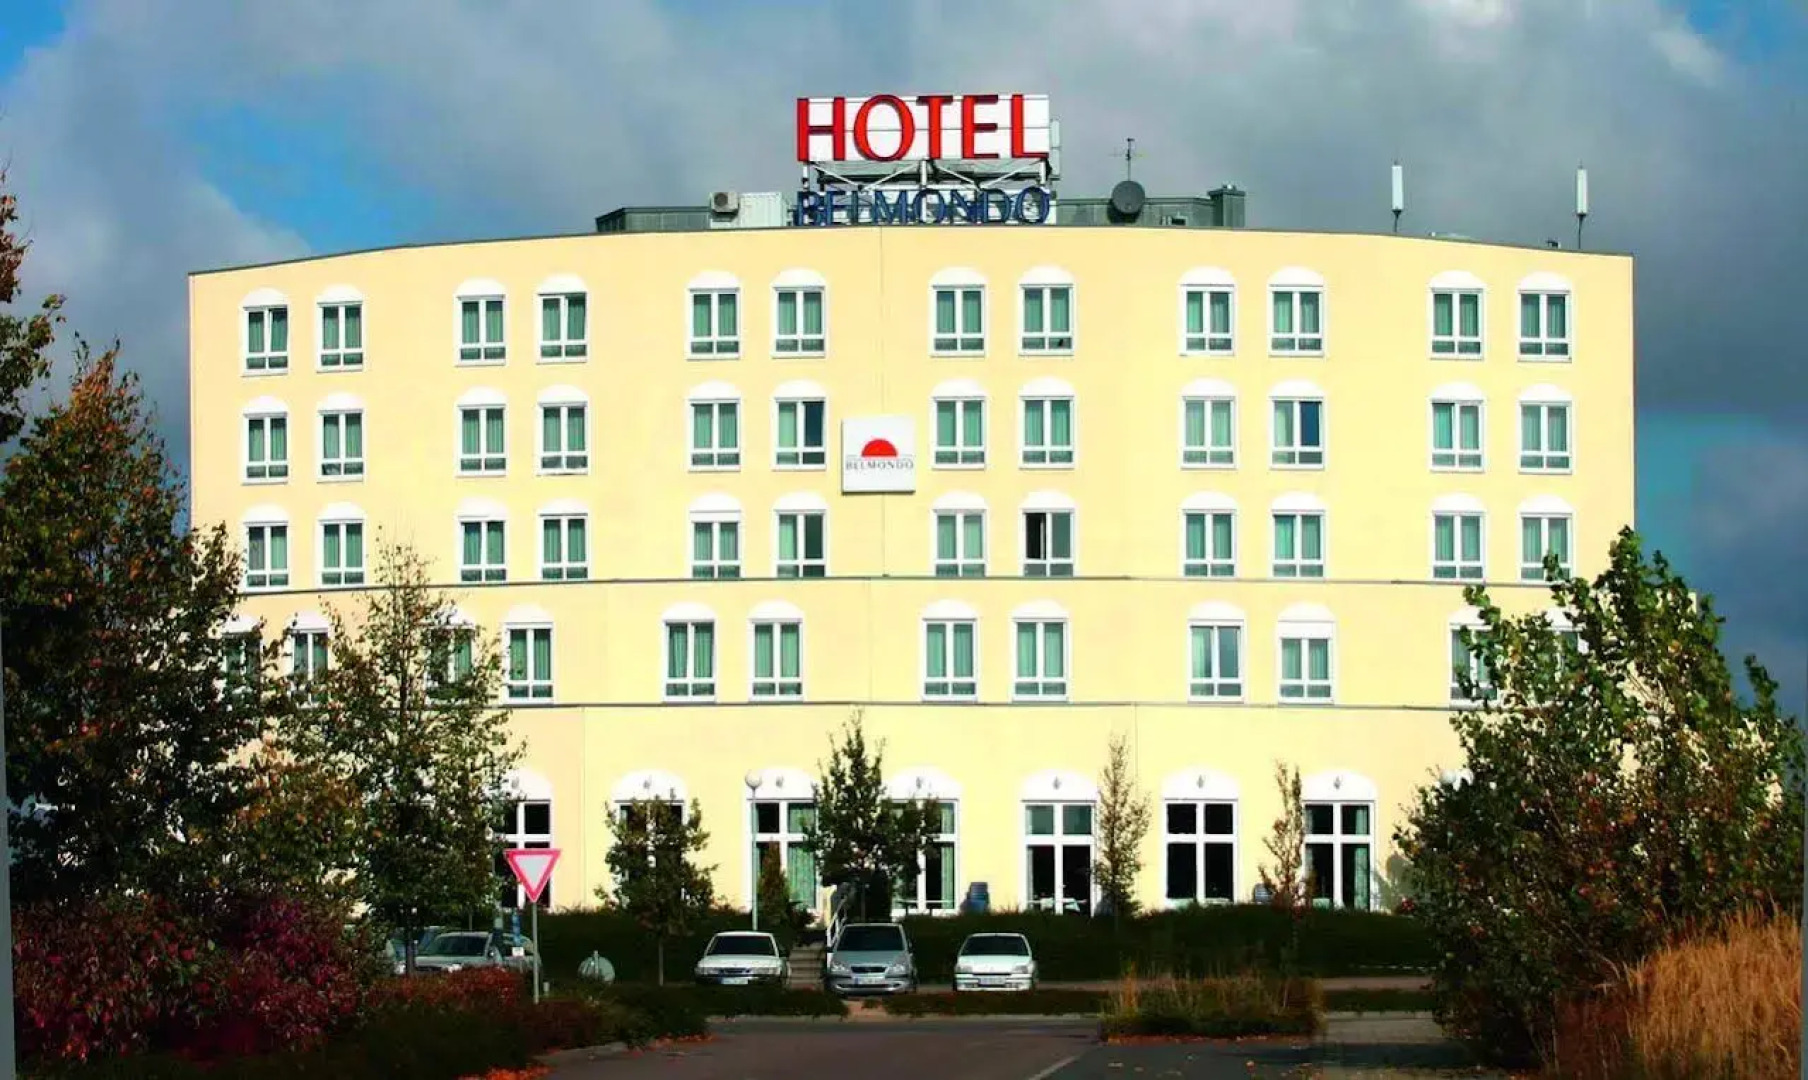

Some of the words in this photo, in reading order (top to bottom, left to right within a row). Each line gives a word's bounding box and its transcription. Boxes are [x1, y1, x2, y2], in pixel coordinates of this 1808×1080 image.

[797, 94, 1049, 162] HOTEL
[796, 187, 1050, 226] BELMONDO
[846, 458, 914, 470] BELMONDO
